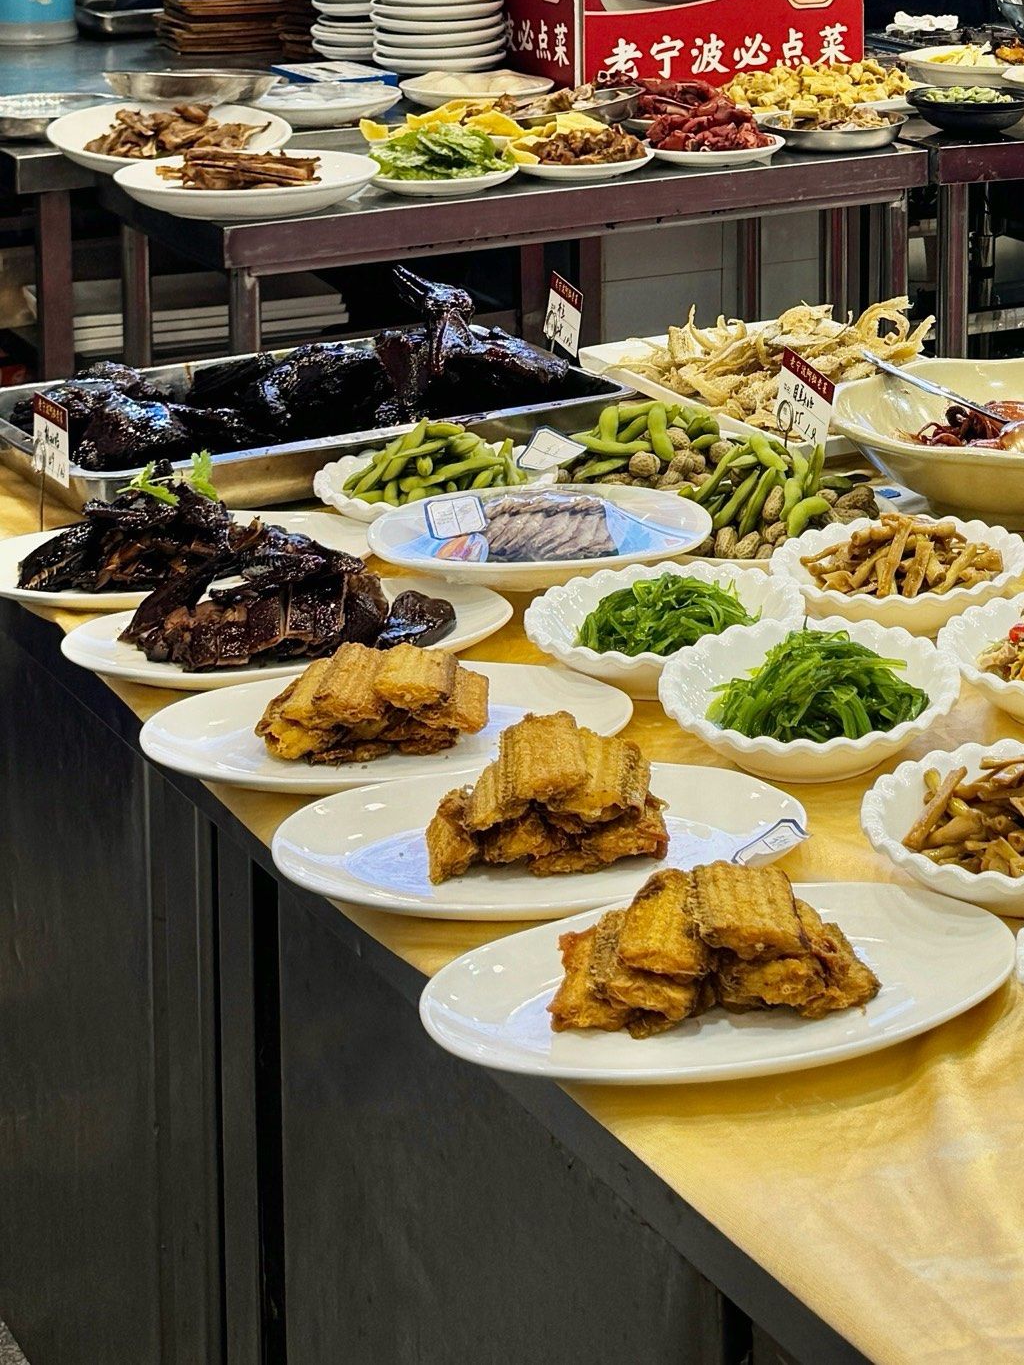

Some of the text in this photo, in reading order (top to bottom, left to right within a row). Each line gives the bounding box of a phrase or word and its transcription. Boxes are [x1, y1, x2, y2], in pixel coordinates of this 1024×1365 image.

[602, 22, 853, 81] 老宁波必点菜
